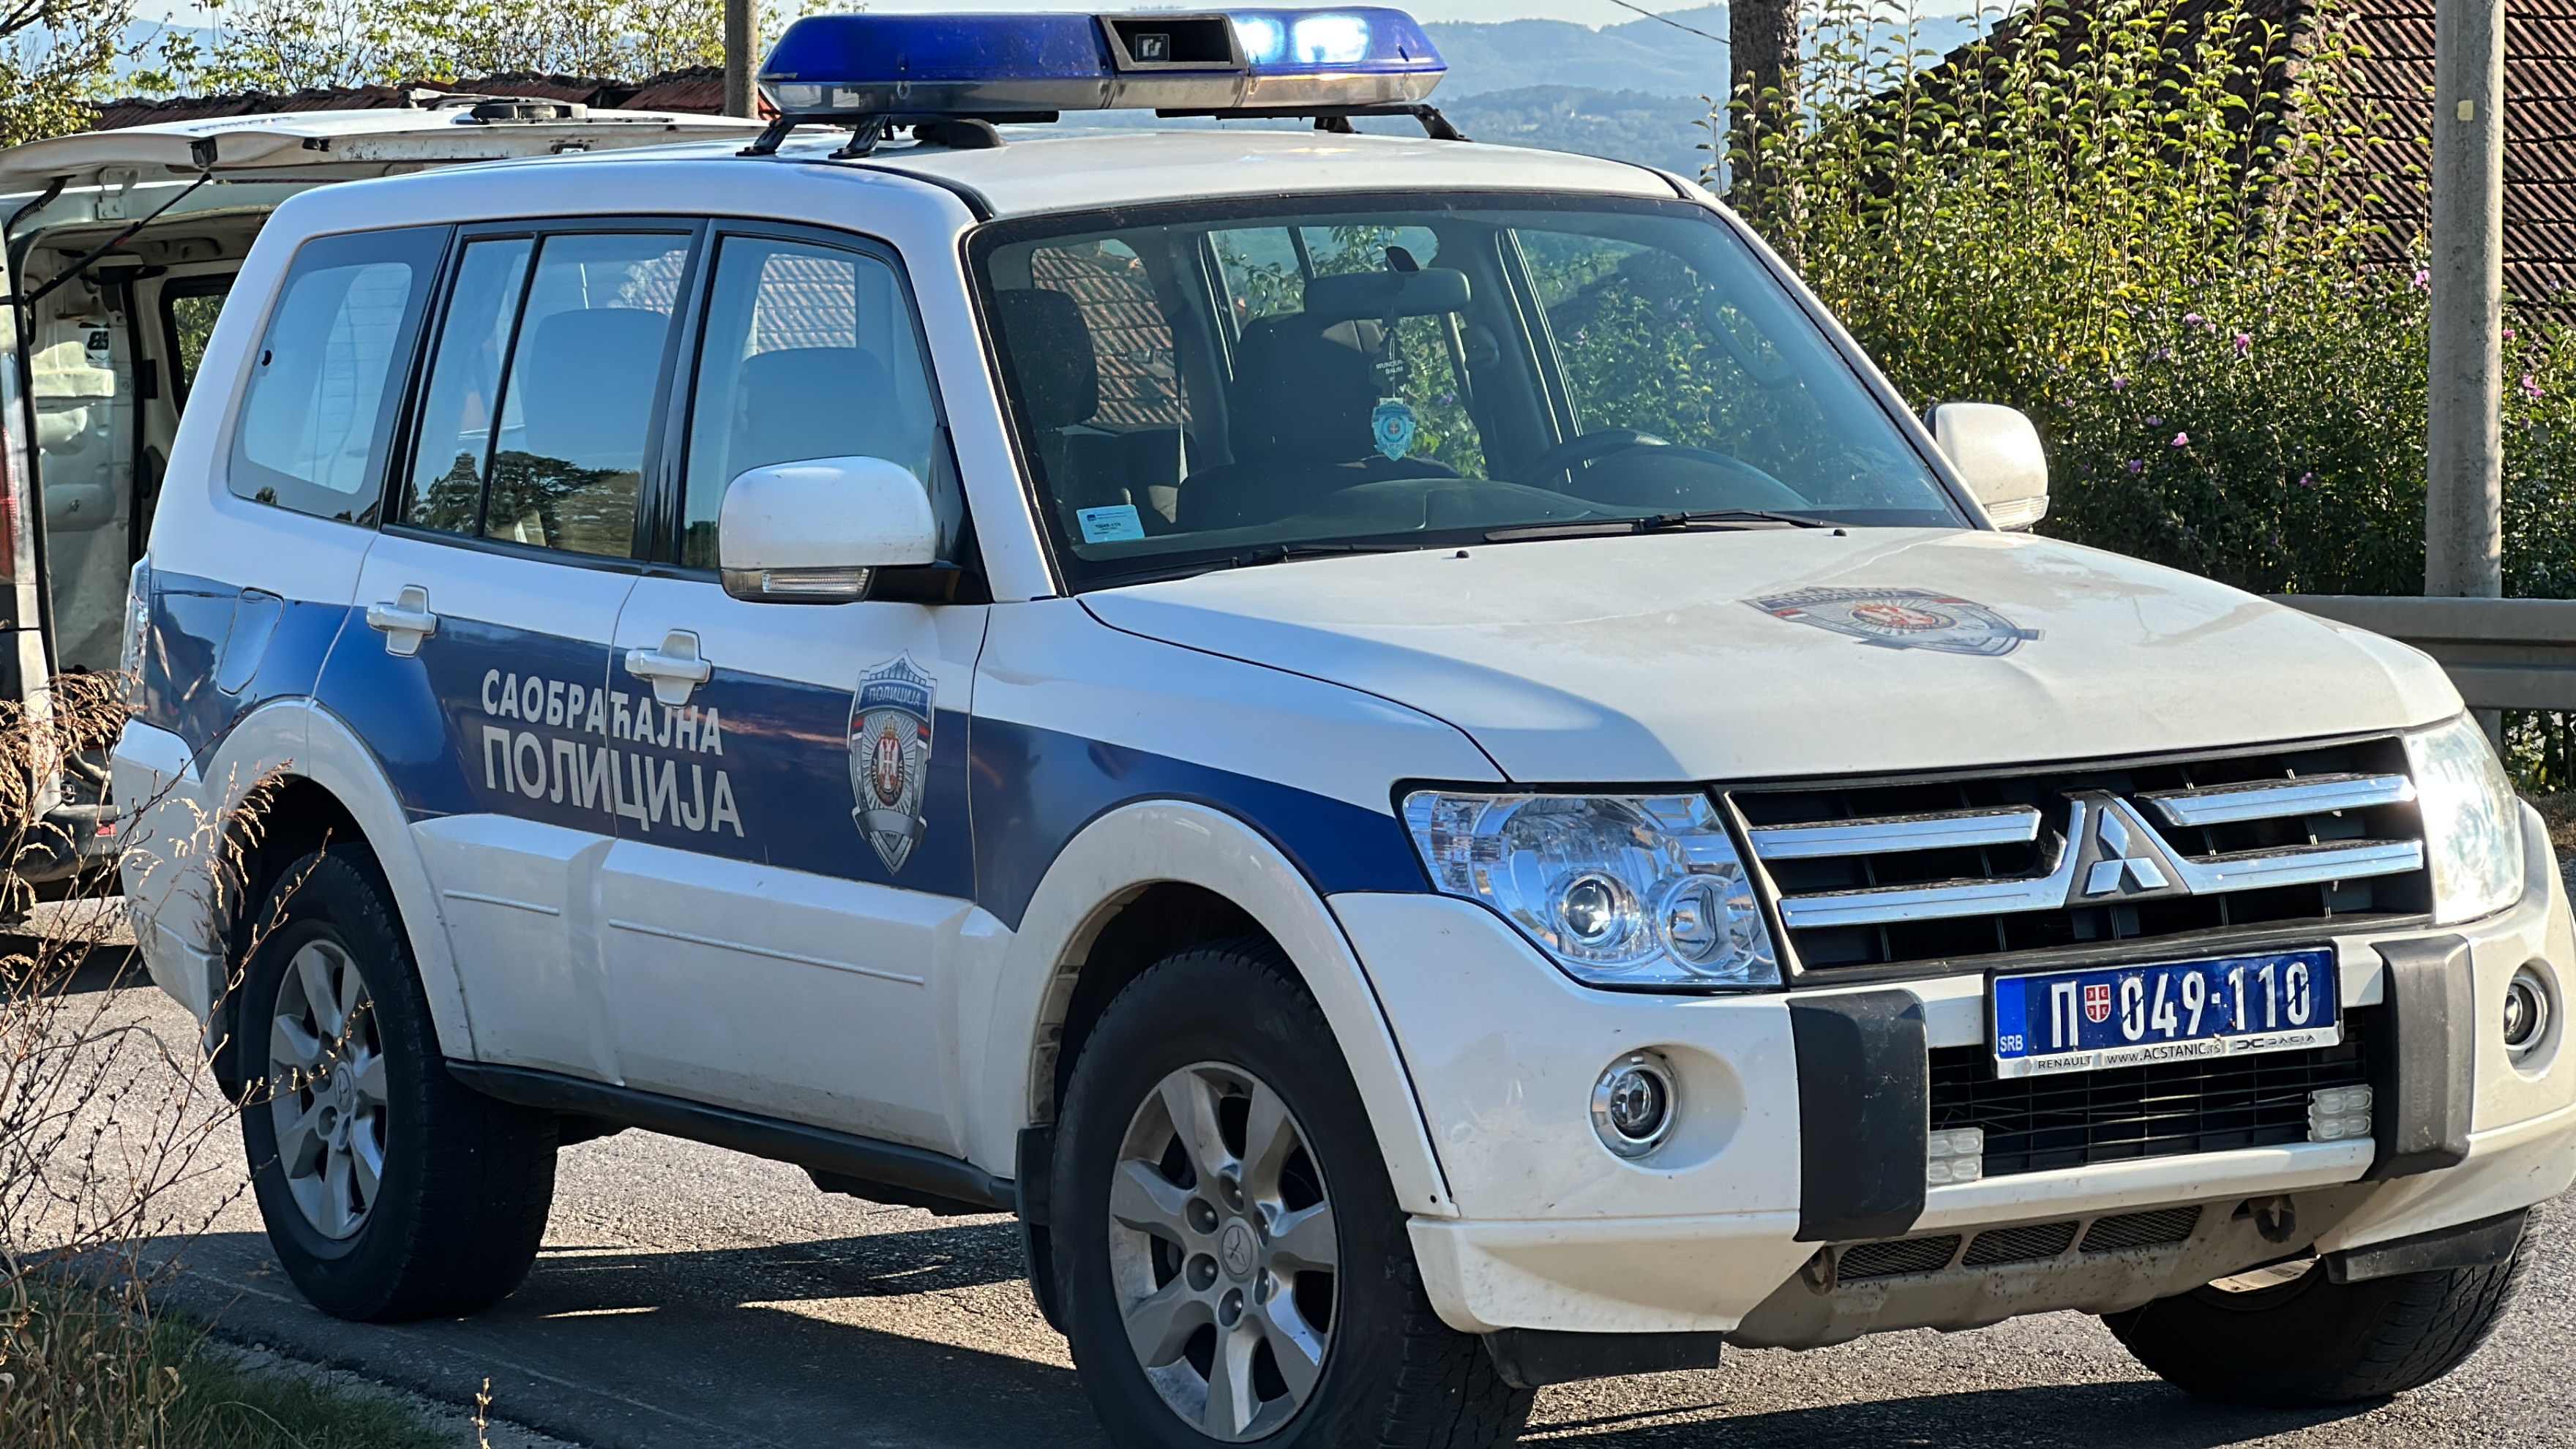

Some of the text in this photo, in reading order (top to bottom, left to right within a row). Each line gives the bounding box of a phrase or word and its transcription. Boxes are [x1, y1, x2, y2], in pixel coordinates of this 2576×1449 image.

[1375, 359, 1405, 370] WUNDER-
[1385, 366, 1403, 375] BAUM
[869, 686, 921, 707] ПОЛИЦИЈА
[482, 669, 723, 756] САОБРАЋАЈНА
[482, 725, 744, 837] ПОЛИЦИЈА
[2051, 962, 2310, 1048] П 049-110
[1999, 1035, 2023, 1052] SRB
[2037, 1035, 2316, 1069] RENAULT www.ACSTANIC.rs DACIA
